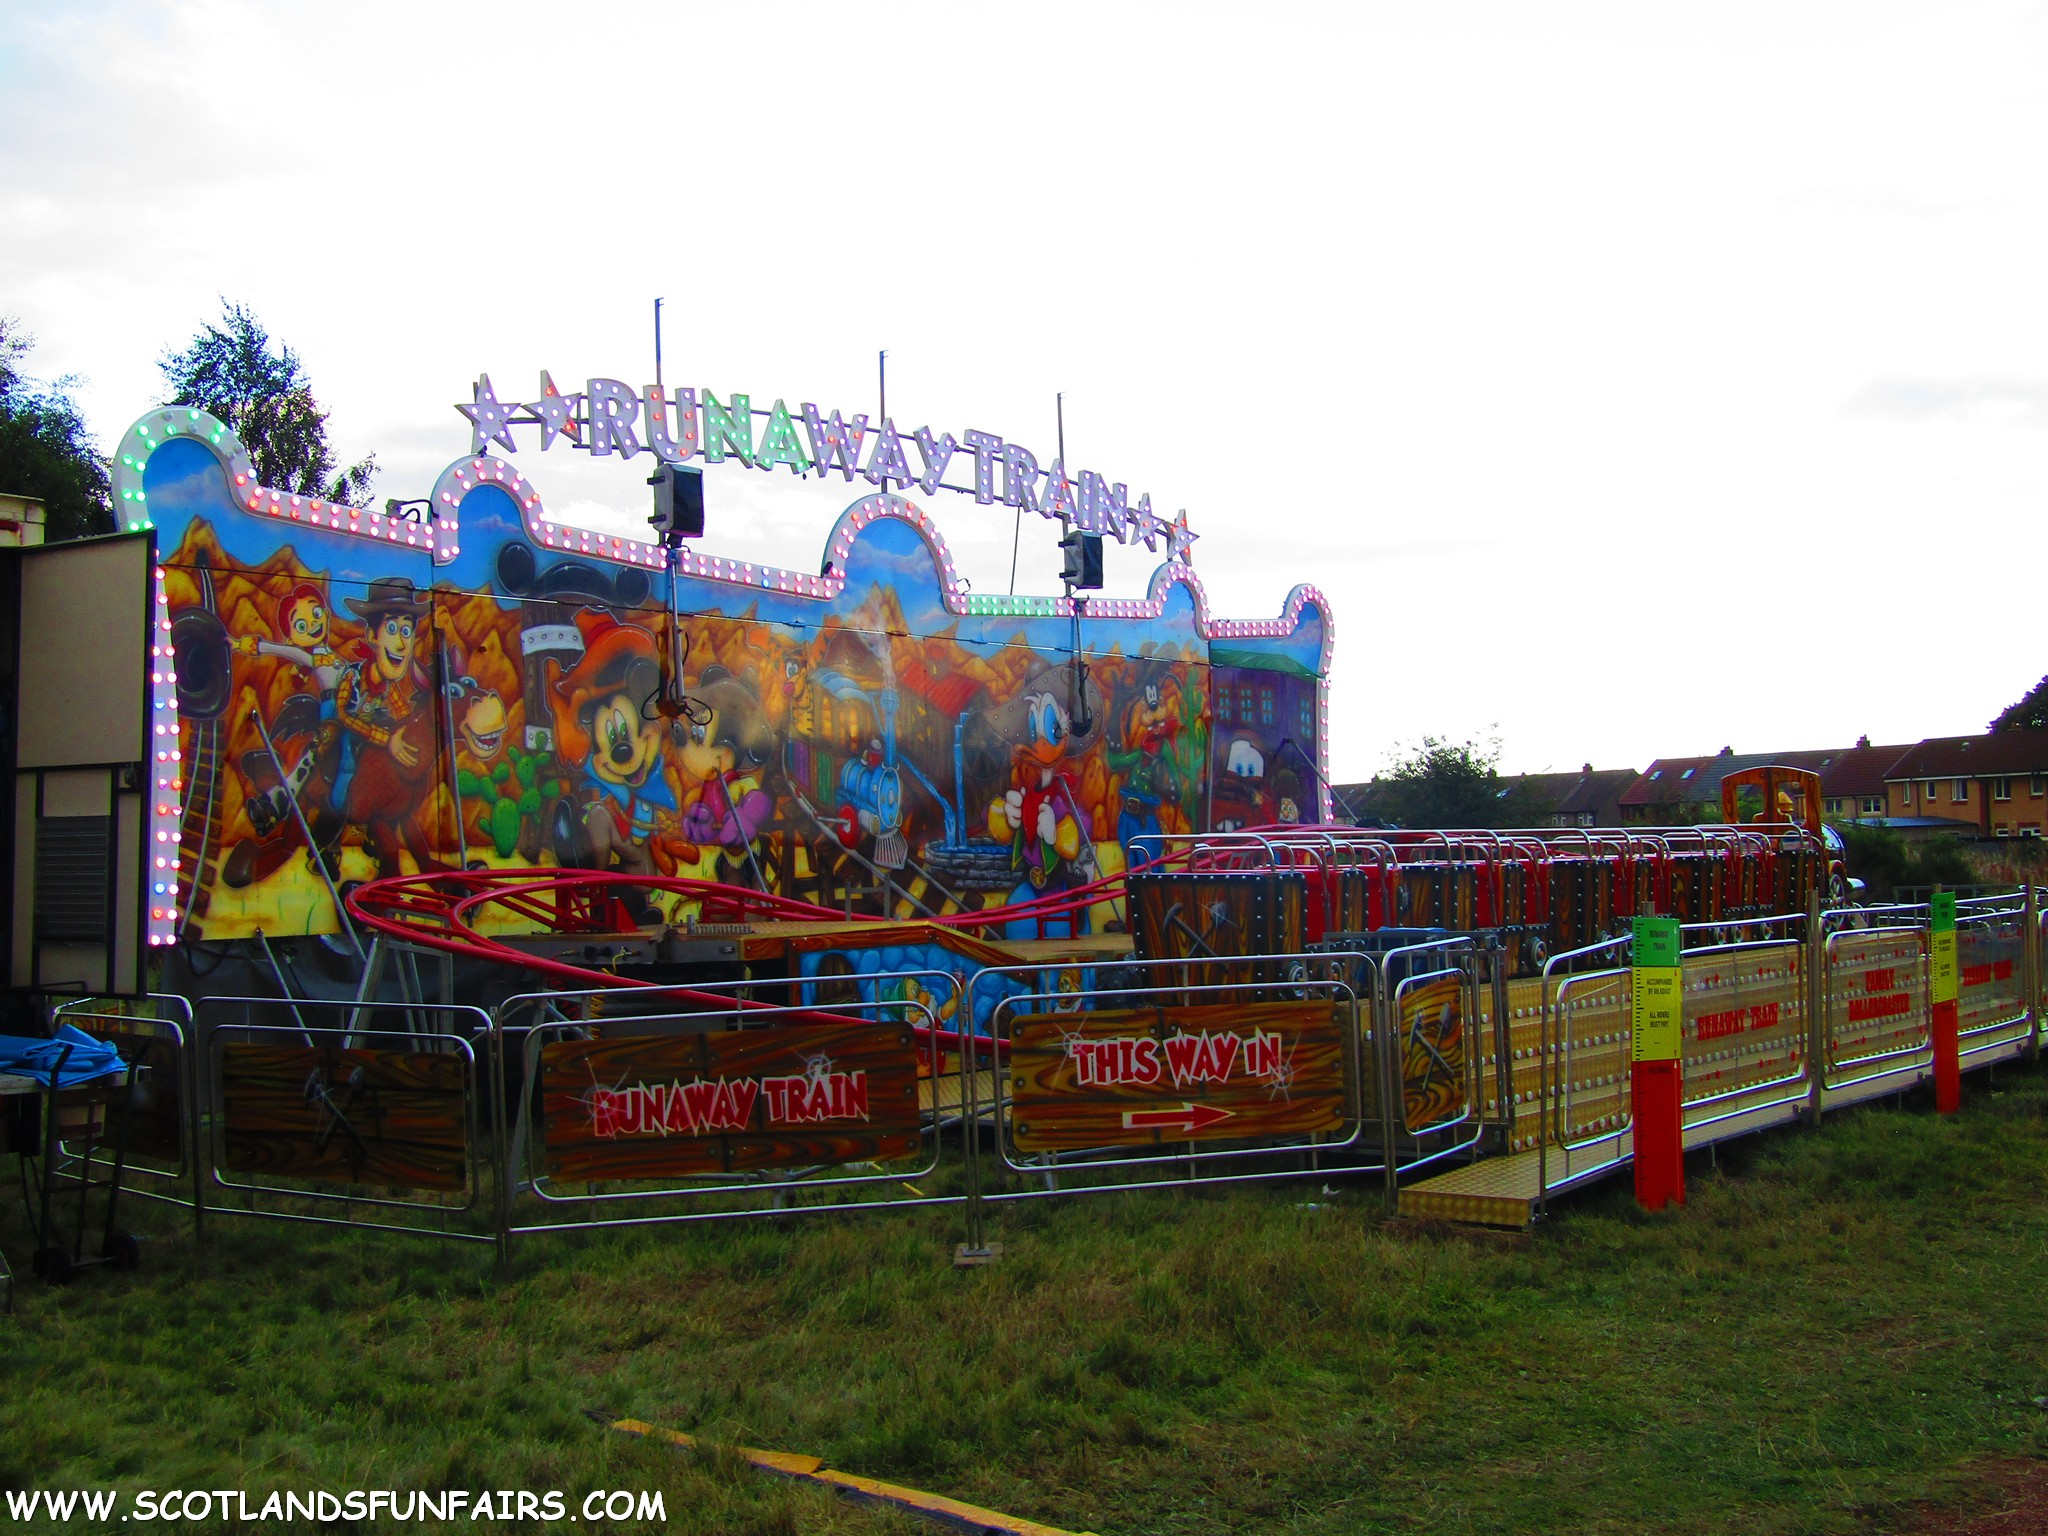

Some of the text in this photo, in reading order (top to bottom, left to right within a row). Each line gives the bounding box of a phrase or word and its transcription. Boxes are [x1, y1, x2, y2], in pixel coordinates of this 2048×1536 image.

[587, 378, 1128, 544] RUNAWAY TRAIN
[1697, 1002, 1779, 1041] RUNAWAY TRAIN
[1069, 1025, 1283, 1090] THIS WAY IN
[595, 1069, 869, 1137] RUNAWAY TRAIN
